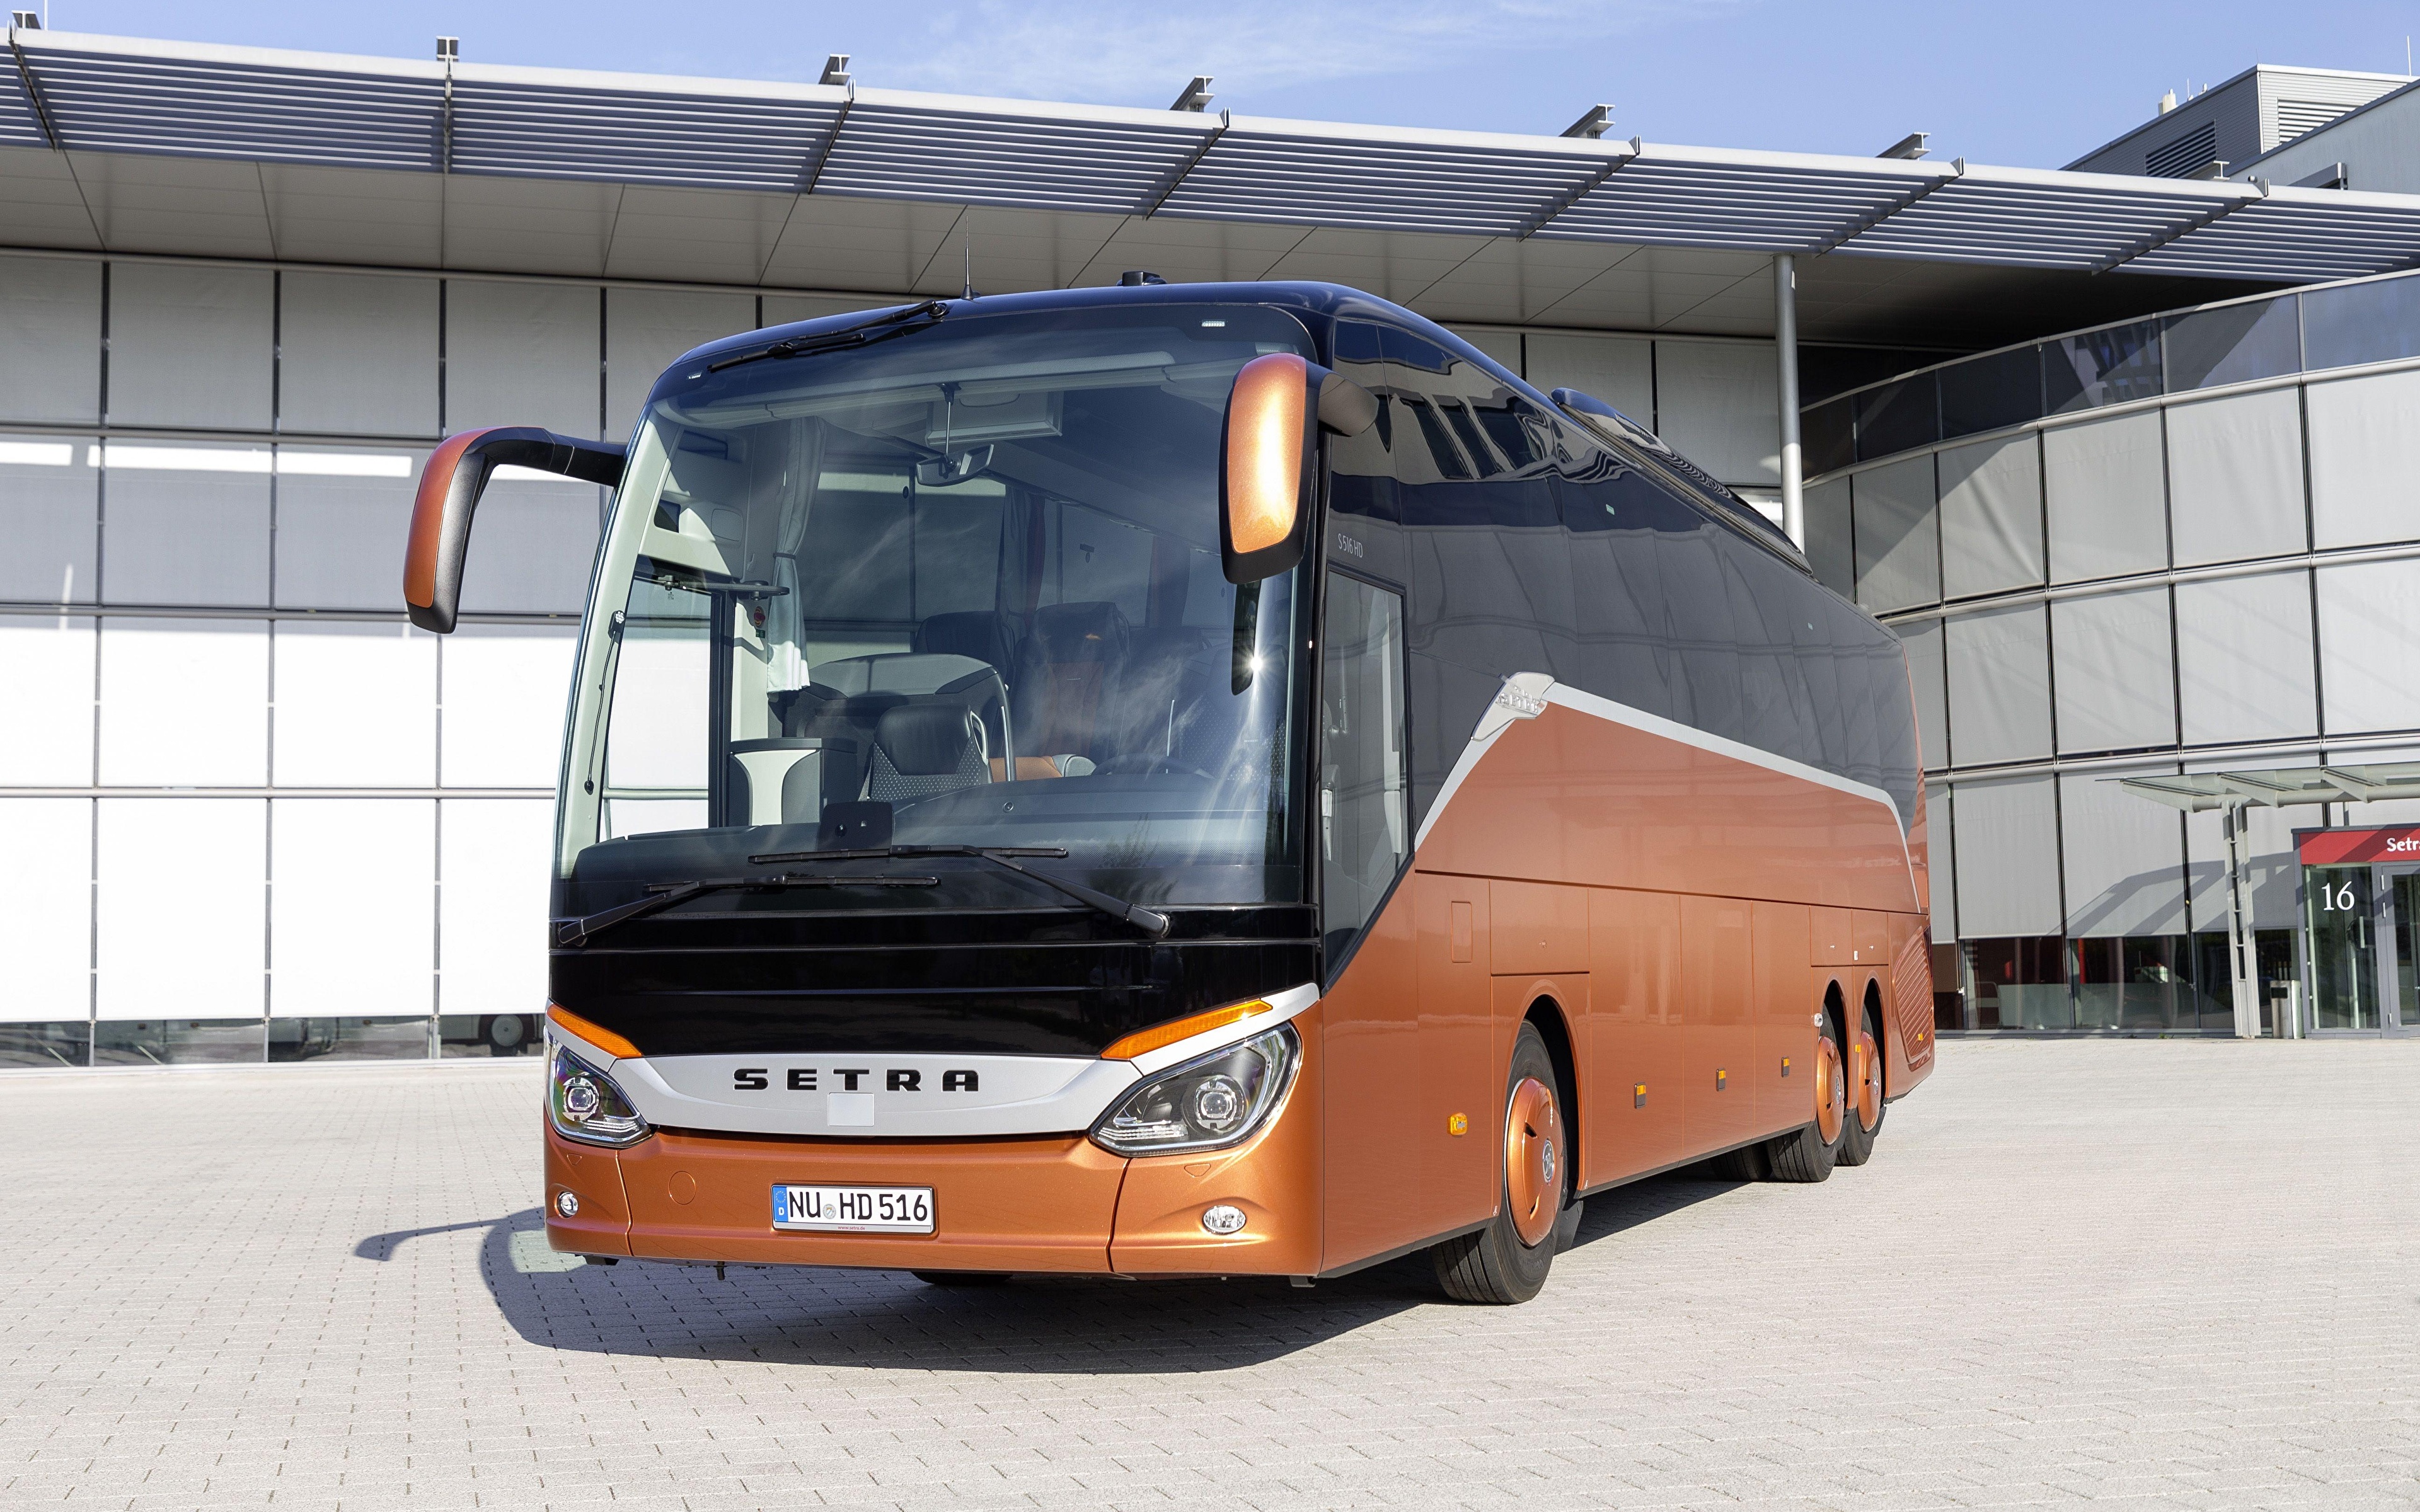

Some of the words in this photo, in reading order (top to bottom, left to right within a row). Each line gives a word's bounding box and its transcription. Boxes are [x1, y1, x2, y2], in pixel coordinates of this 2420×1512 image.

[1338, 533, 1342, 549] S
[1343, 536, 1353, 554] 516
[1353, 540, 1363, 558] HD
[2387, 837, 2420, 852] Setr
[2321, 881, 2354, 910] 16
[734, 1068, 979, 1092] SETRA
[778, 1206, 785, 1216] D
[789, 1191, 821, 1218] NU
[839, 1193, 872, 1220] HD
[879, 1194, 928, 1222] 516
